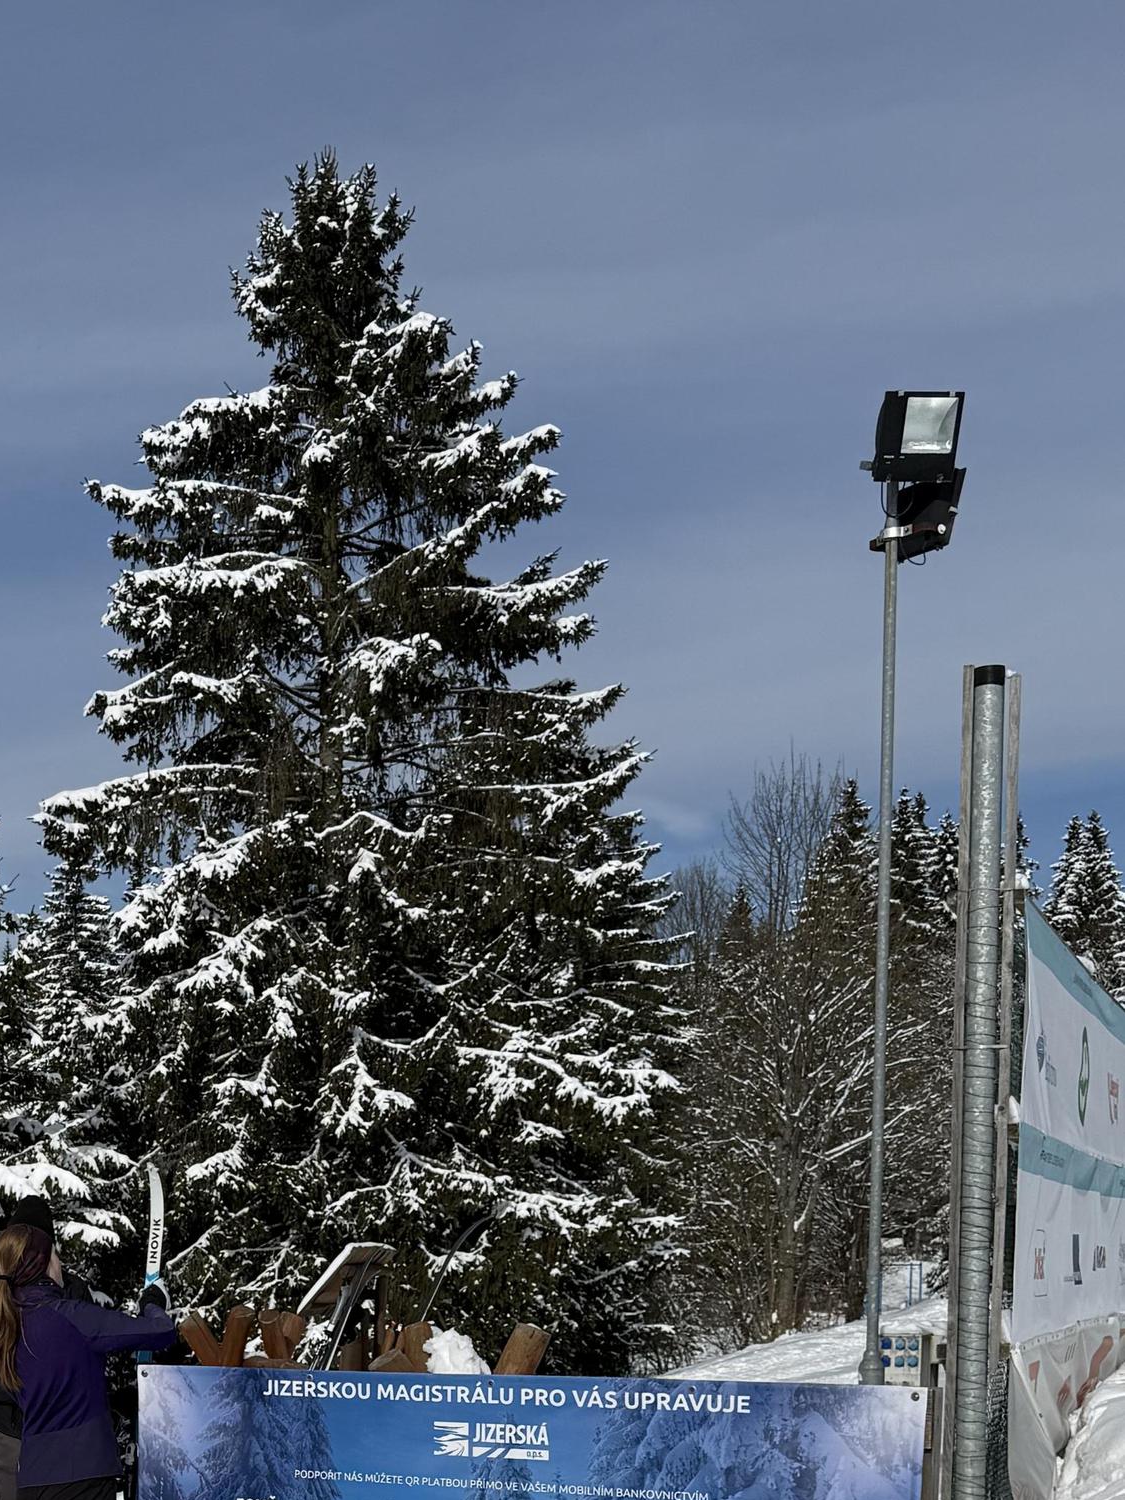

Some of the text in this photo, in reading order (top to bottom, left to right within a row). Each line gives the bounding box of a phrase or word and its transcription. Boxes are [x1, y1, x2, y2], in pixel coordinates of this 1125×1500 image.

[149, 1218, 162, 1264] INOVIK
[263, 1379, 751, 1414] JIZERSKOU MAGISTRÁLU PRO VÁS UPRAVUJE
[473, 1422, 549, 1446] JIZERSKÁ
[294, 1469, 342, 1481] PODPOŘIT
[344, 1470, 363, 1482] NÁS
[365, 1471, 403, 1485] MŮŽETE
[405, 1476, 420, 1487] QR
[421, 1476, 468, 1489] PLATBOU
[470, 1477, 503, 1490] PŘÍMO
[505, 1481, 519, 1492] VE
[521, 1481, 556, 1493] VAŠEM
[559, 1484, 614, 1498] MOBILNÍM
